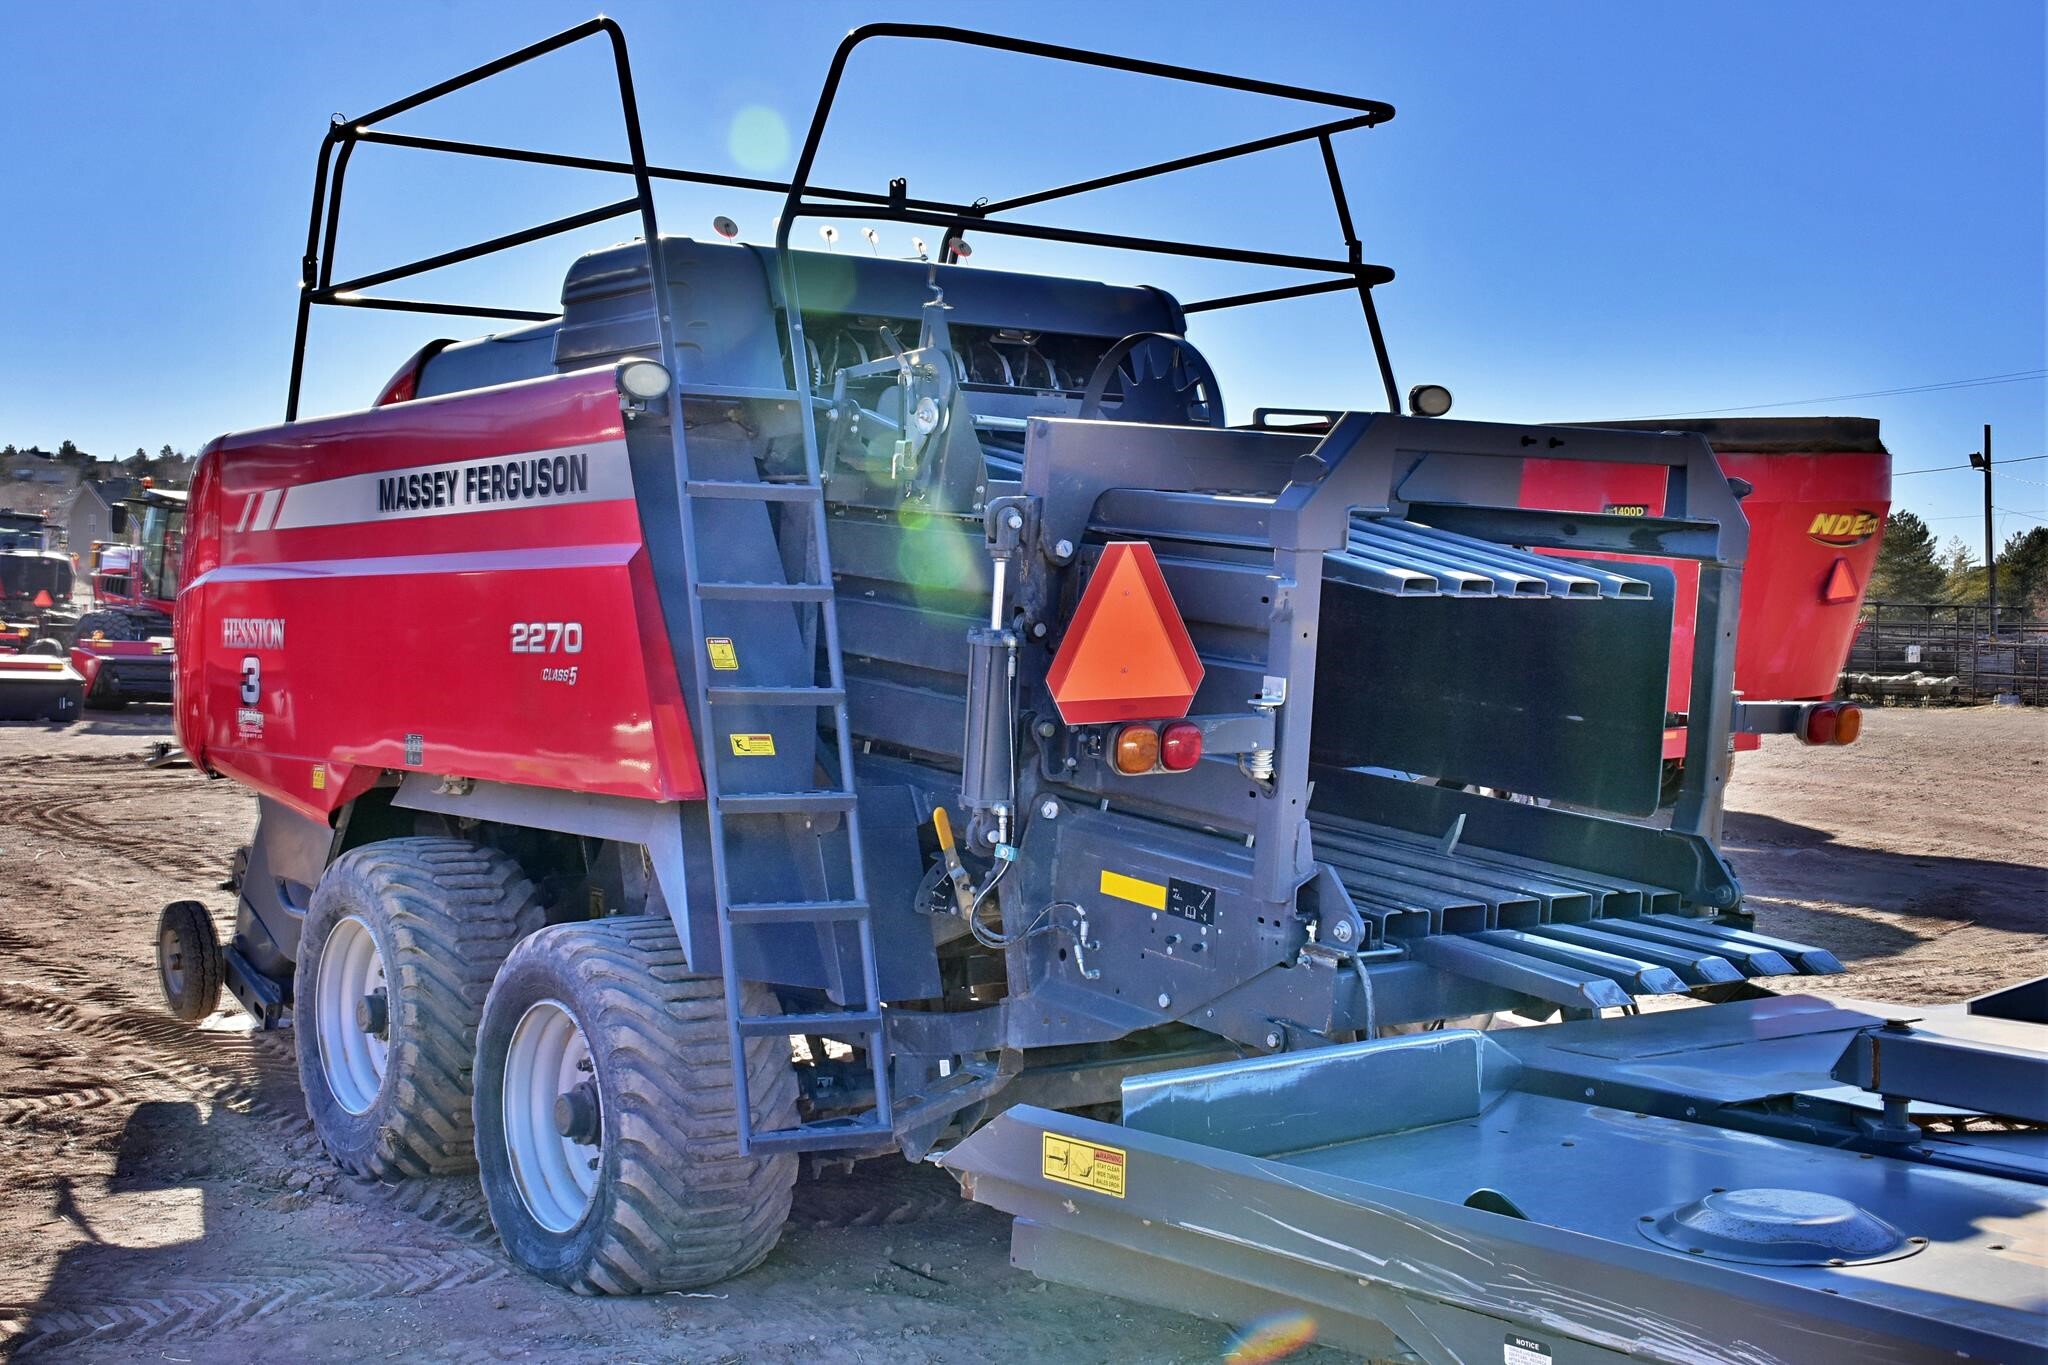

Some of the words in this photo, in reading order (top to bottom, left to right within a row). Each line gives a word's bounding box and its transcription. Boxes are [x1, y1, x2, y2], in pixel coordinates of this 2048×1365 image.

[379, 470, 460, 513] MASSEY
[464, 453, 589, 504] FERGUSON
[223, 618, 286, 650] HESSTON
[510, 621, 583, 654] 2270
[241, 655, 261, 706] 3
[1099, 1152, 1121, 1163] WARNING
[1515, 1338, 1540, 1350] NOTICE
